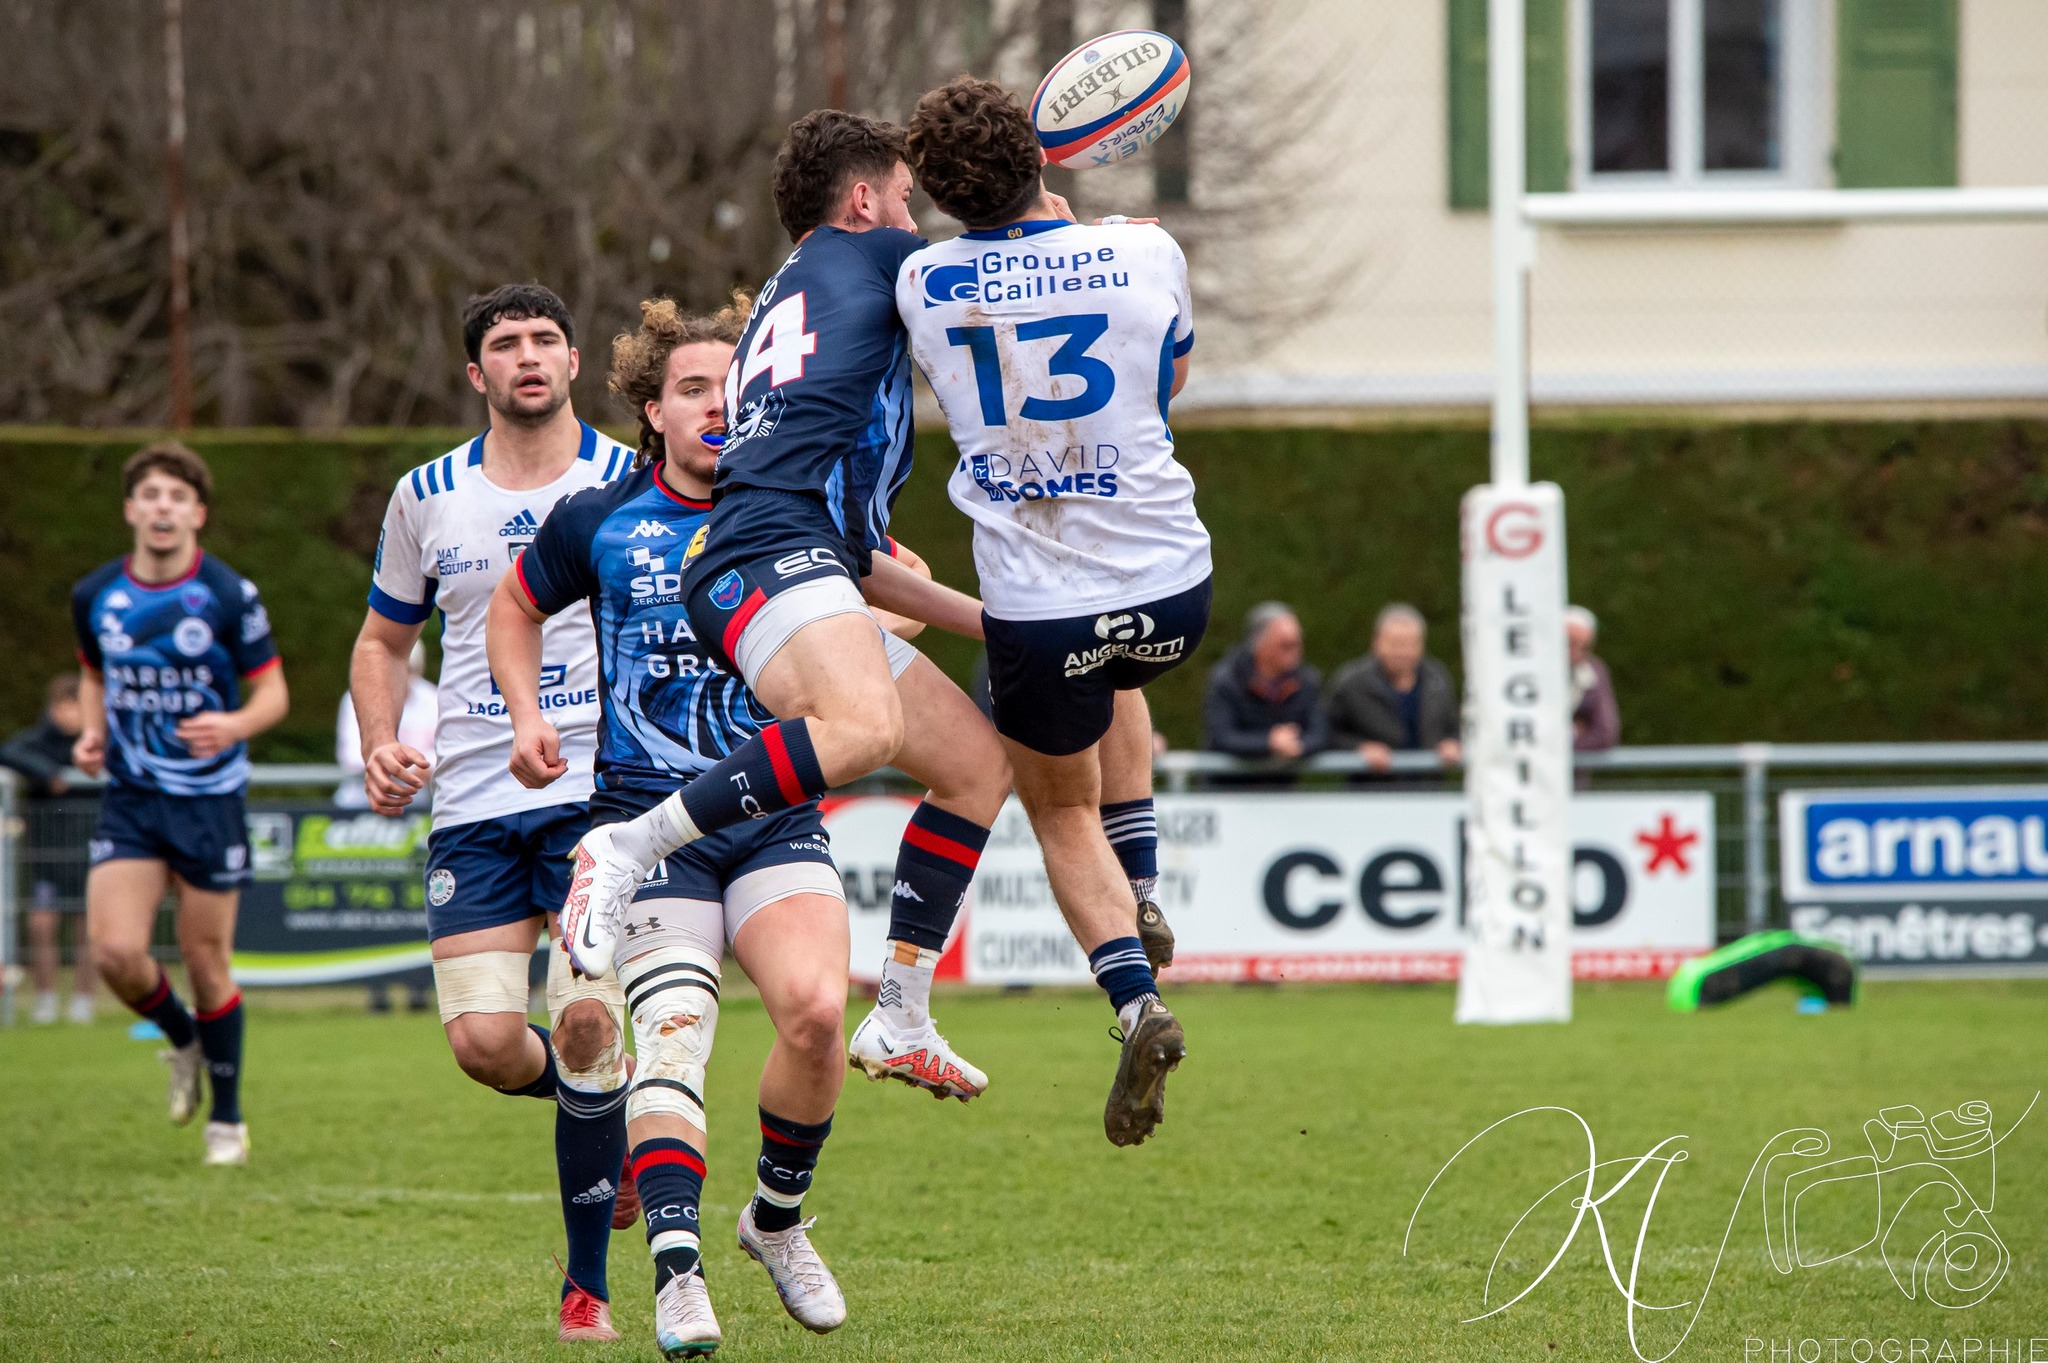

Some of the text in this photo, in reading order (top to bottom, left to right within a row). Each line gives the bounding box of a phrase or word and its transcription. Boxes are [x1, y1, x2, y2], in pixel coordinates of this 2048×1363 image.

[1048, 42, 1161, 125] GILBERT
[1007, 228, 1023, 240] 60
[982, 247, 1115, 274] Groupe
[984, 272, 1129, 303] Cailleau
[945, 313, 1115, 426] 13
[990, 444, 1119, 478] DAVID
[998, 473, 1118, 502] GOMES
[499, 525, 539, 536] adida
[475, 559, 489, 570] 31
[633, 594, 681, 605] SERVICE
[467, 689, 597, 715] LAGARIGUE
[1505, 673, 1546, 952] GRILLON
[1262, 816, 1630, 931] celo
[572, 1188, 616, 1204] adidas
